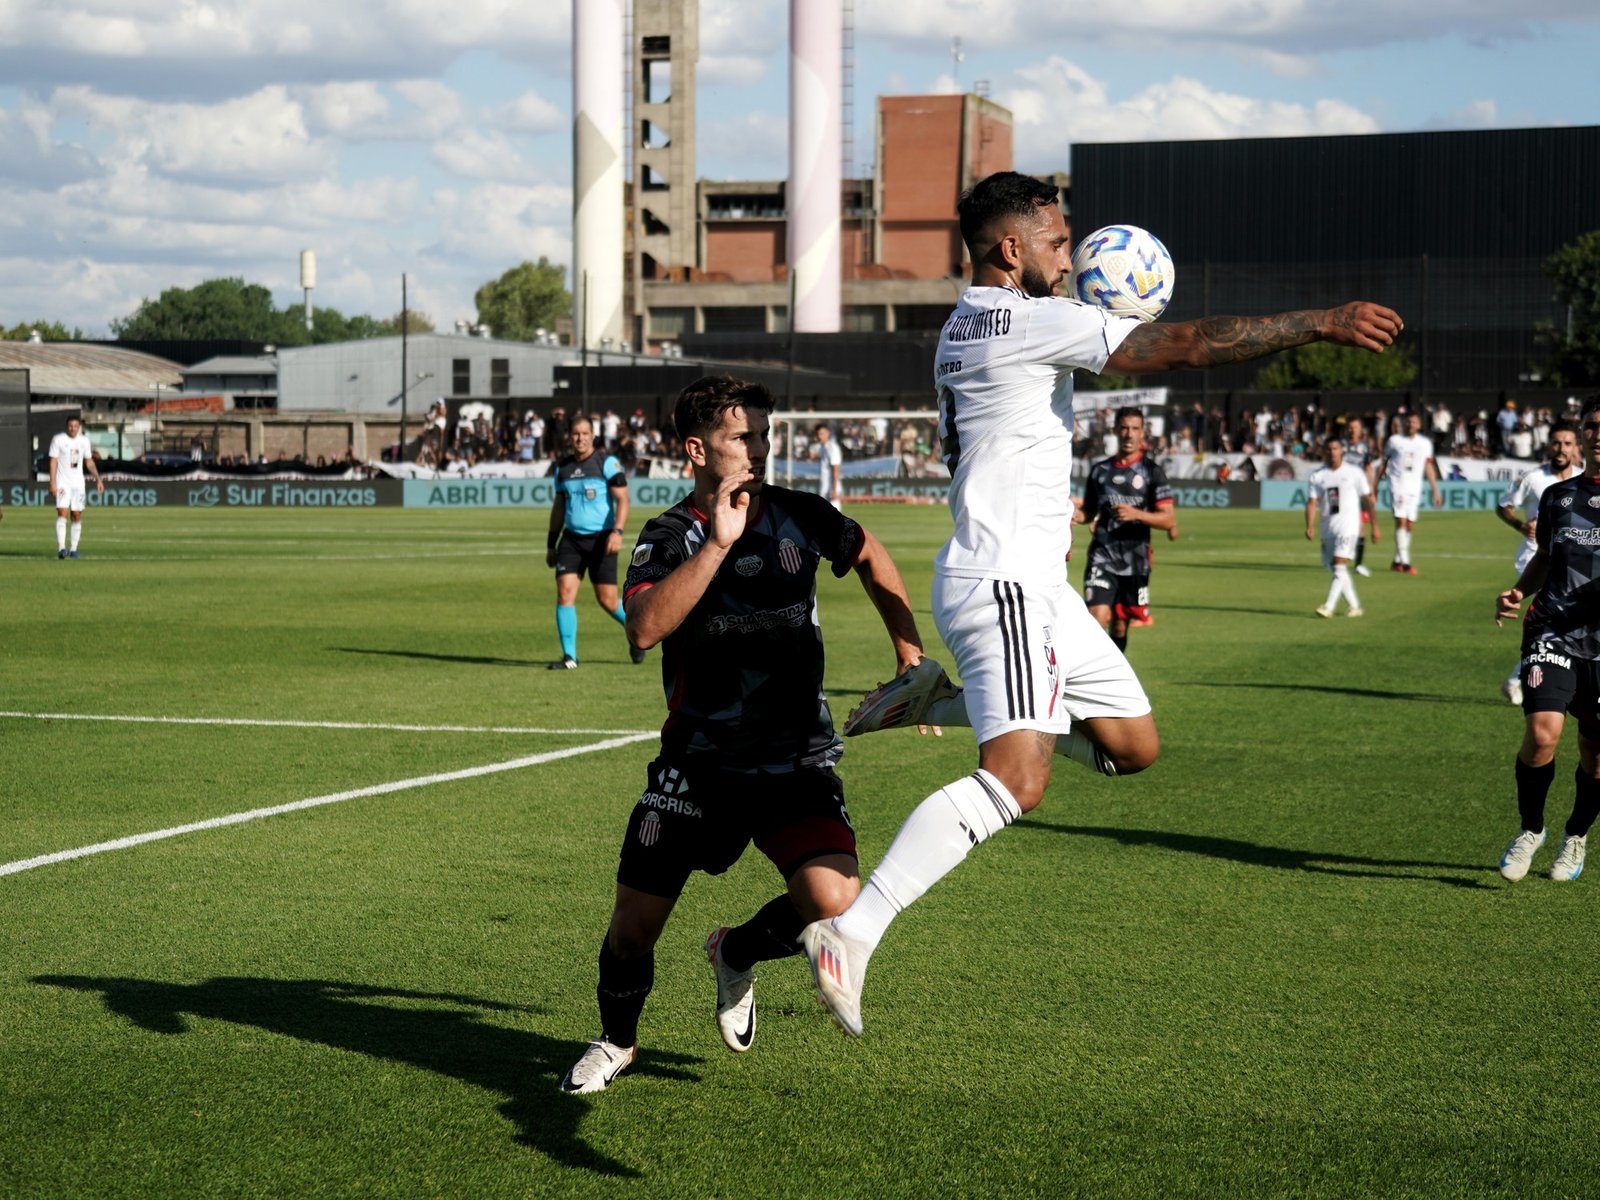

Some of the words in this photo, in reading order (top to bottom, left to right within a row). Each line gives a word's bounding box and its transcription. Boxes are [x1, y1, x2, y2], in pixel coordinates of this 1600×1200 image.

[949, 308, 1011, 341] UNLIMITED
[11, 486, 48, 506] Sur
[227, 485, 266, 505] Sur
[272, 484, 376, 506] Finanzas
[428, 481, 486, 504] ABRÍ
[493, 486, 525, 504] TU
[637, 485, 693, 504] GRA
[1418, 485, 1500, 505] CUENT
[1569, 527, 1590, 538] Sur
